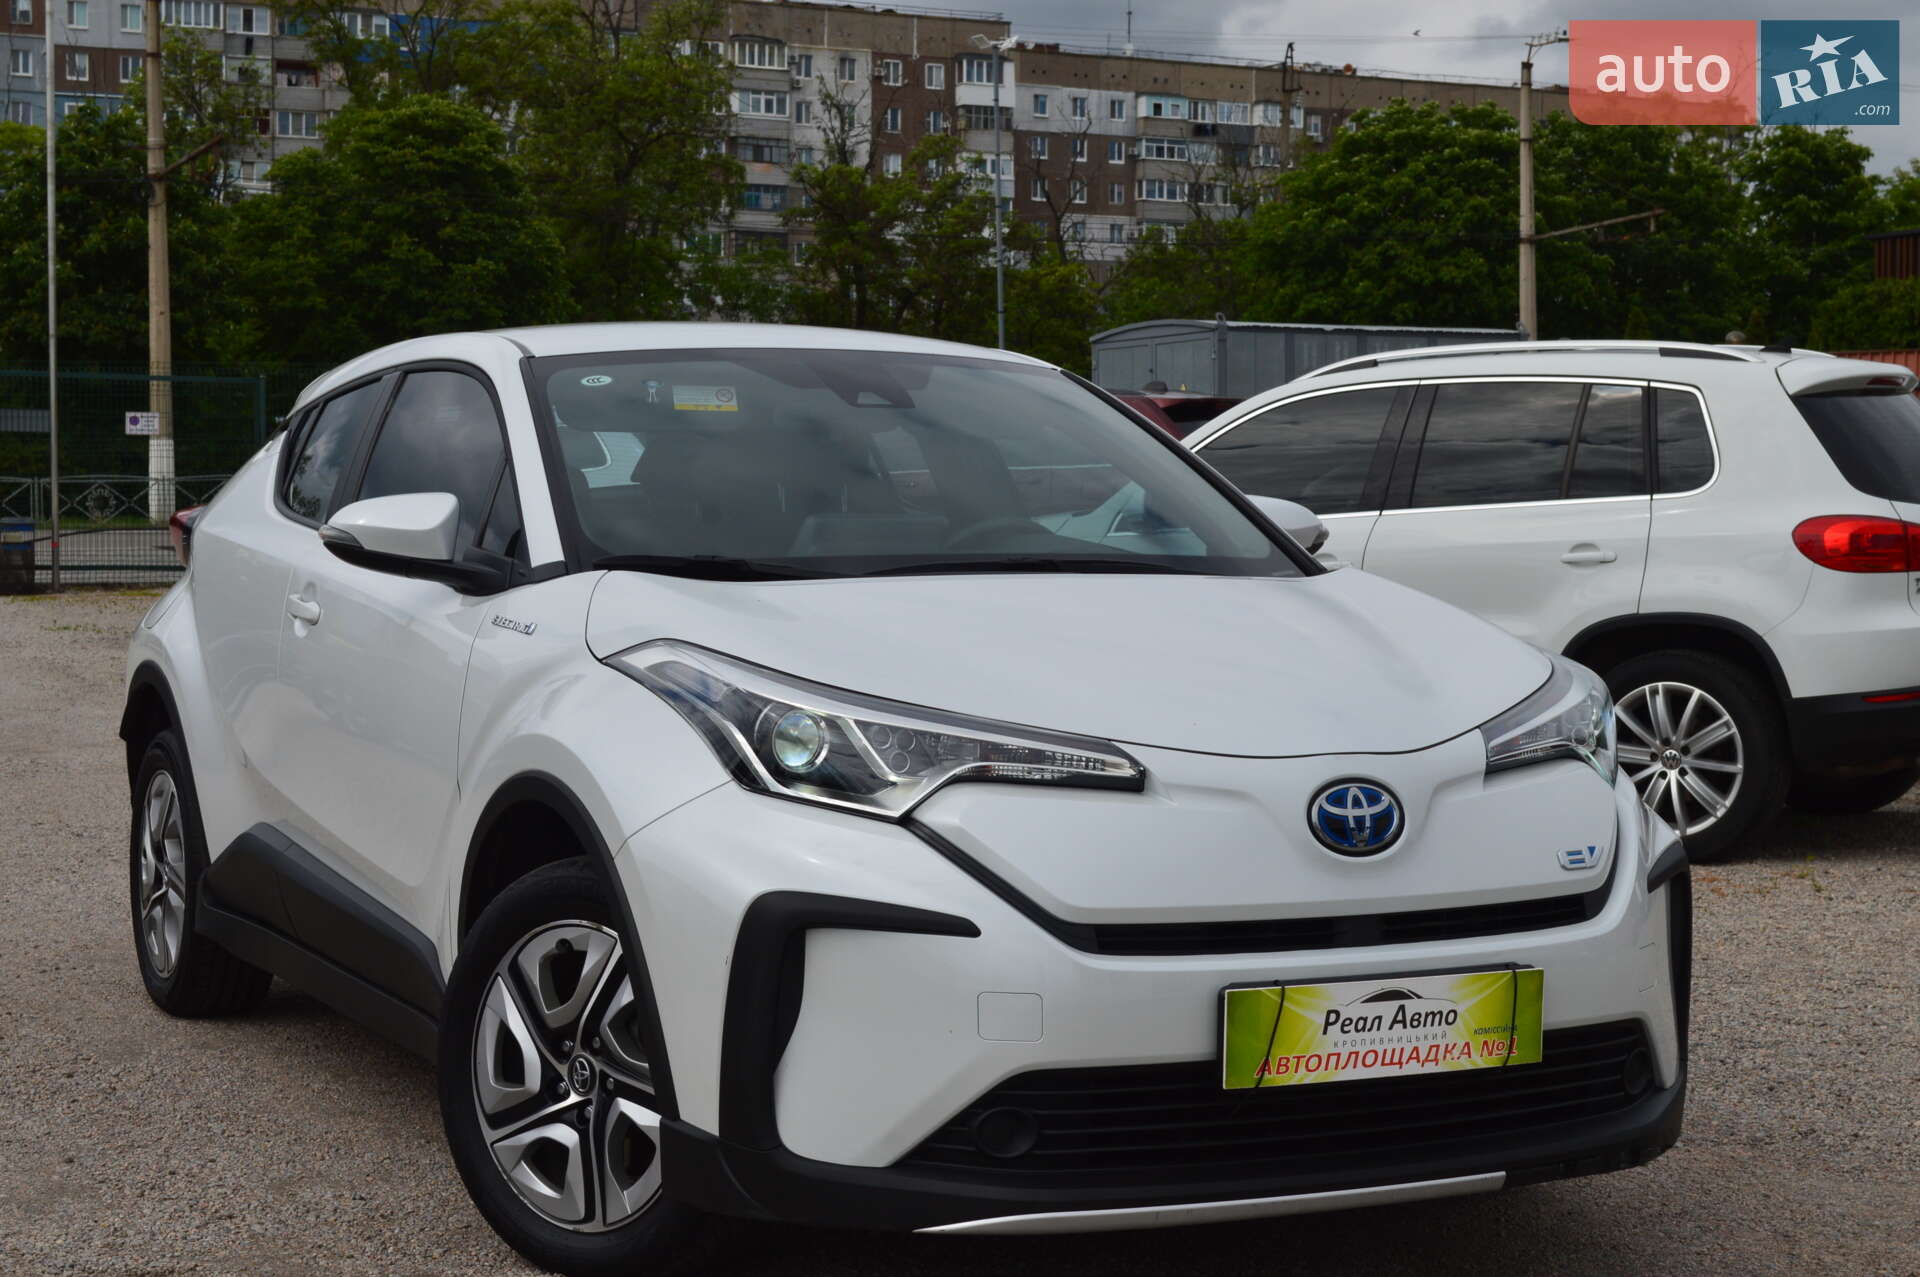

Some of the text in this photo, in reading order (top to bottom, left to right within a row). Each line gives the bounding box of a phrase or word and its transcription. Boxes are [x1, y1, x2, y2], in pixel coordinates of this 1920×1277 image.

[1322, 1004, 1458, 1036] Реал Авто
[1333, 1030, 1448, 1048] КРОПИВНИЦЬКИЙ
[1255, 1040, 1472, 1077] АВТОПЛОЩАДКА
